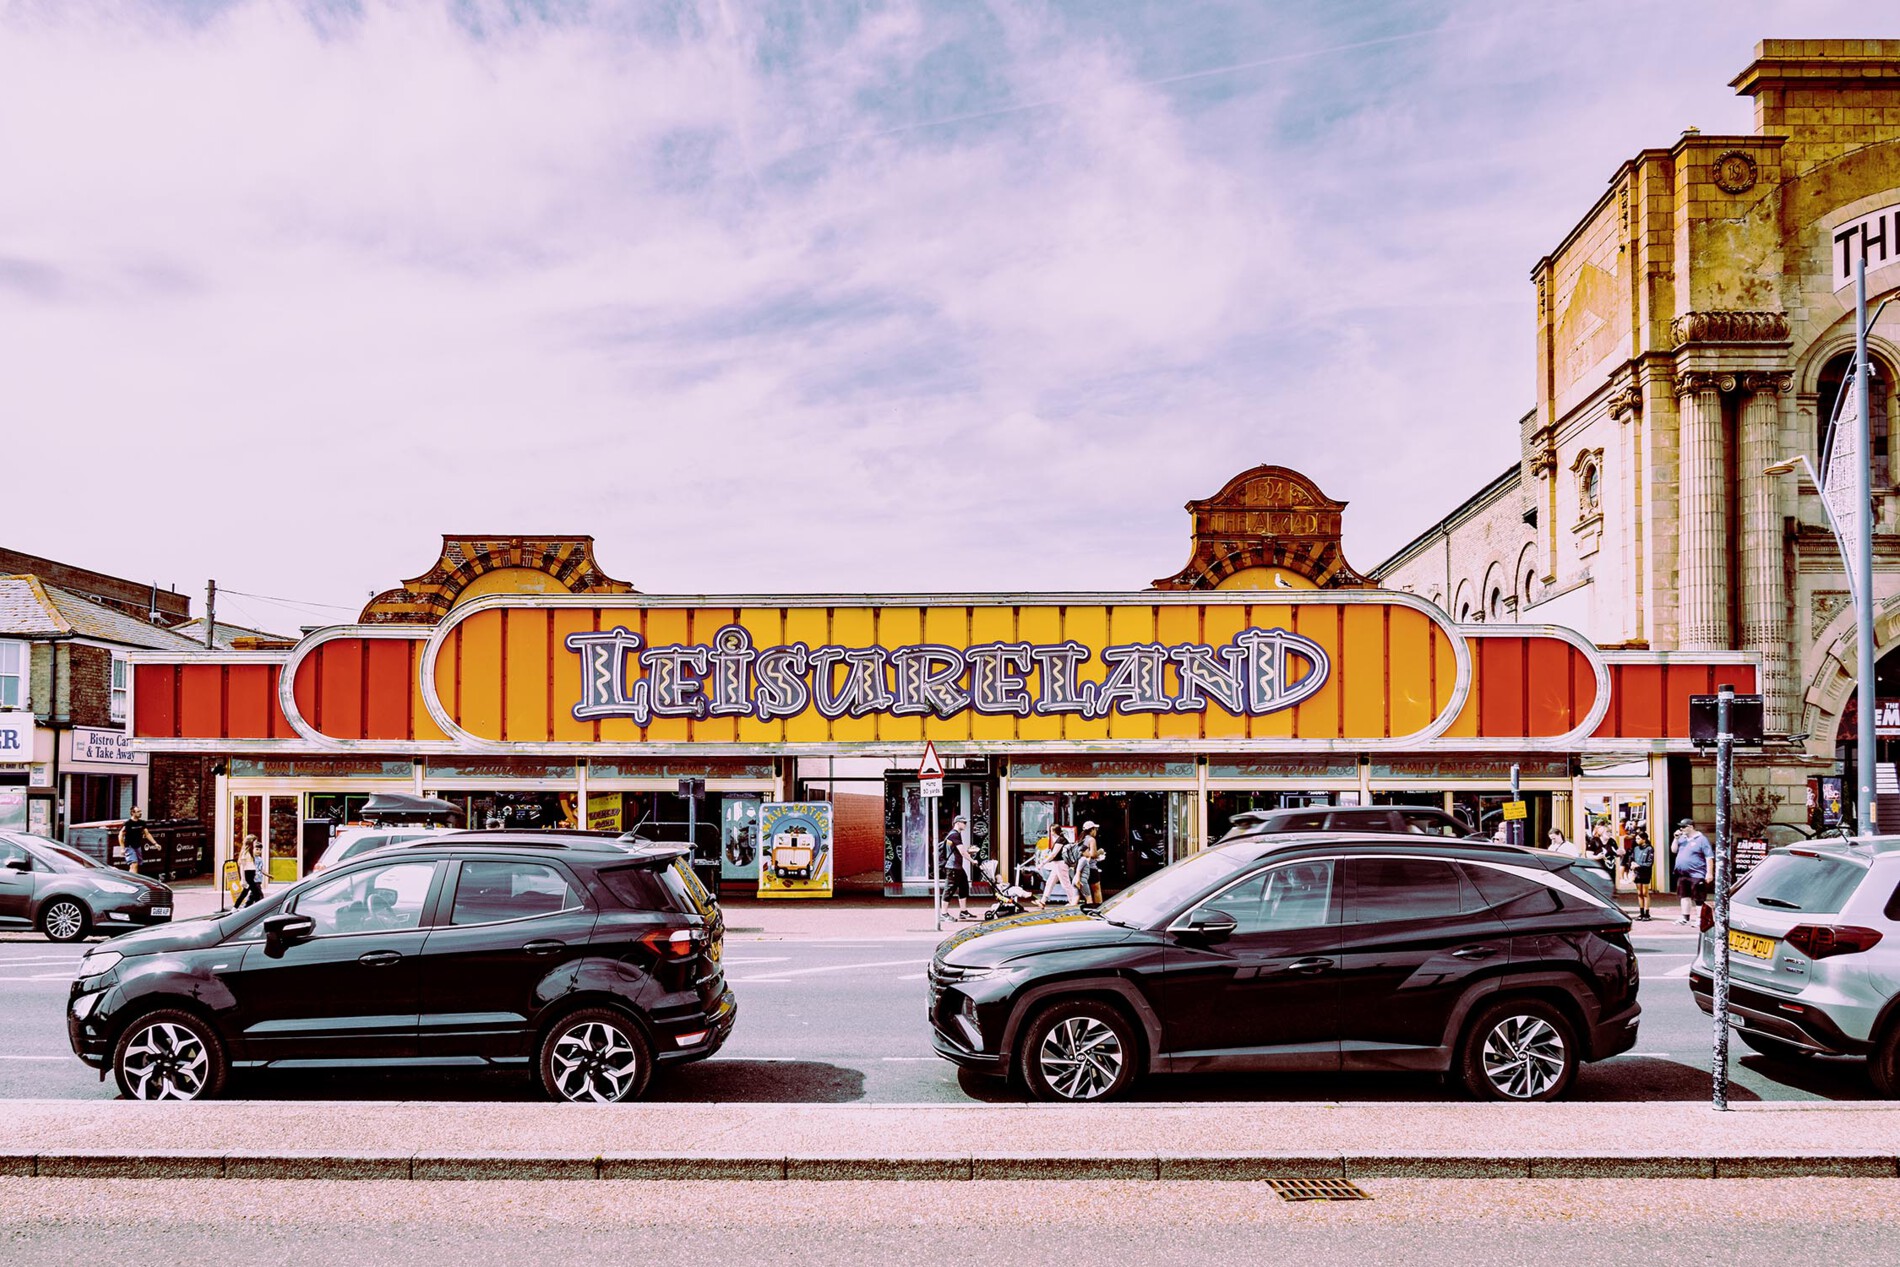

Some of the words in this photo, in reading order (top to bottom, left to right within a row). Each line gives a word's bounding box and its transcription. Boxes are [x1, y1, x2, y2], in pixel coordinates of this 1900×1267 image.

[1834, 211, 1900, 278] TH
[1210, 513, 1247, 533] THE
[1253, 513, 1330, 533] ARCADE
[567, 626, 1331, 726] LEISURELAND
[90, 732, 114, 746] Bistro
[86, 745, 93, 758] &
[95, 746, 114, 759] Take
[116, 747, 135, 762] Away
[264, 761, 290, 774] WIN
[293, 761, 332, 774] MEGA
[333, 761, 383, 774] PRIZES
[617, 764, 663, 776] TICKET
[666, 764, 706, 775] GAME
[708, 764, 747, 775] ZONE
[1040, 762, 1093, 774] CASINO
[1096, 762, 1166, 774] JACKPOTS
[1390, 763, 1436, 774] FAMILY
[1438, 762, 1549, 774] ENTERTAINENT
[762, 804, 788, 833] WAVE
[793, 803, 831, 833] PATROL
[1737, 841, 1767, 850] EMPIRE
[1729, 933, 1750, 950] LD23
[1752, 939, 1771, 955] WDU
